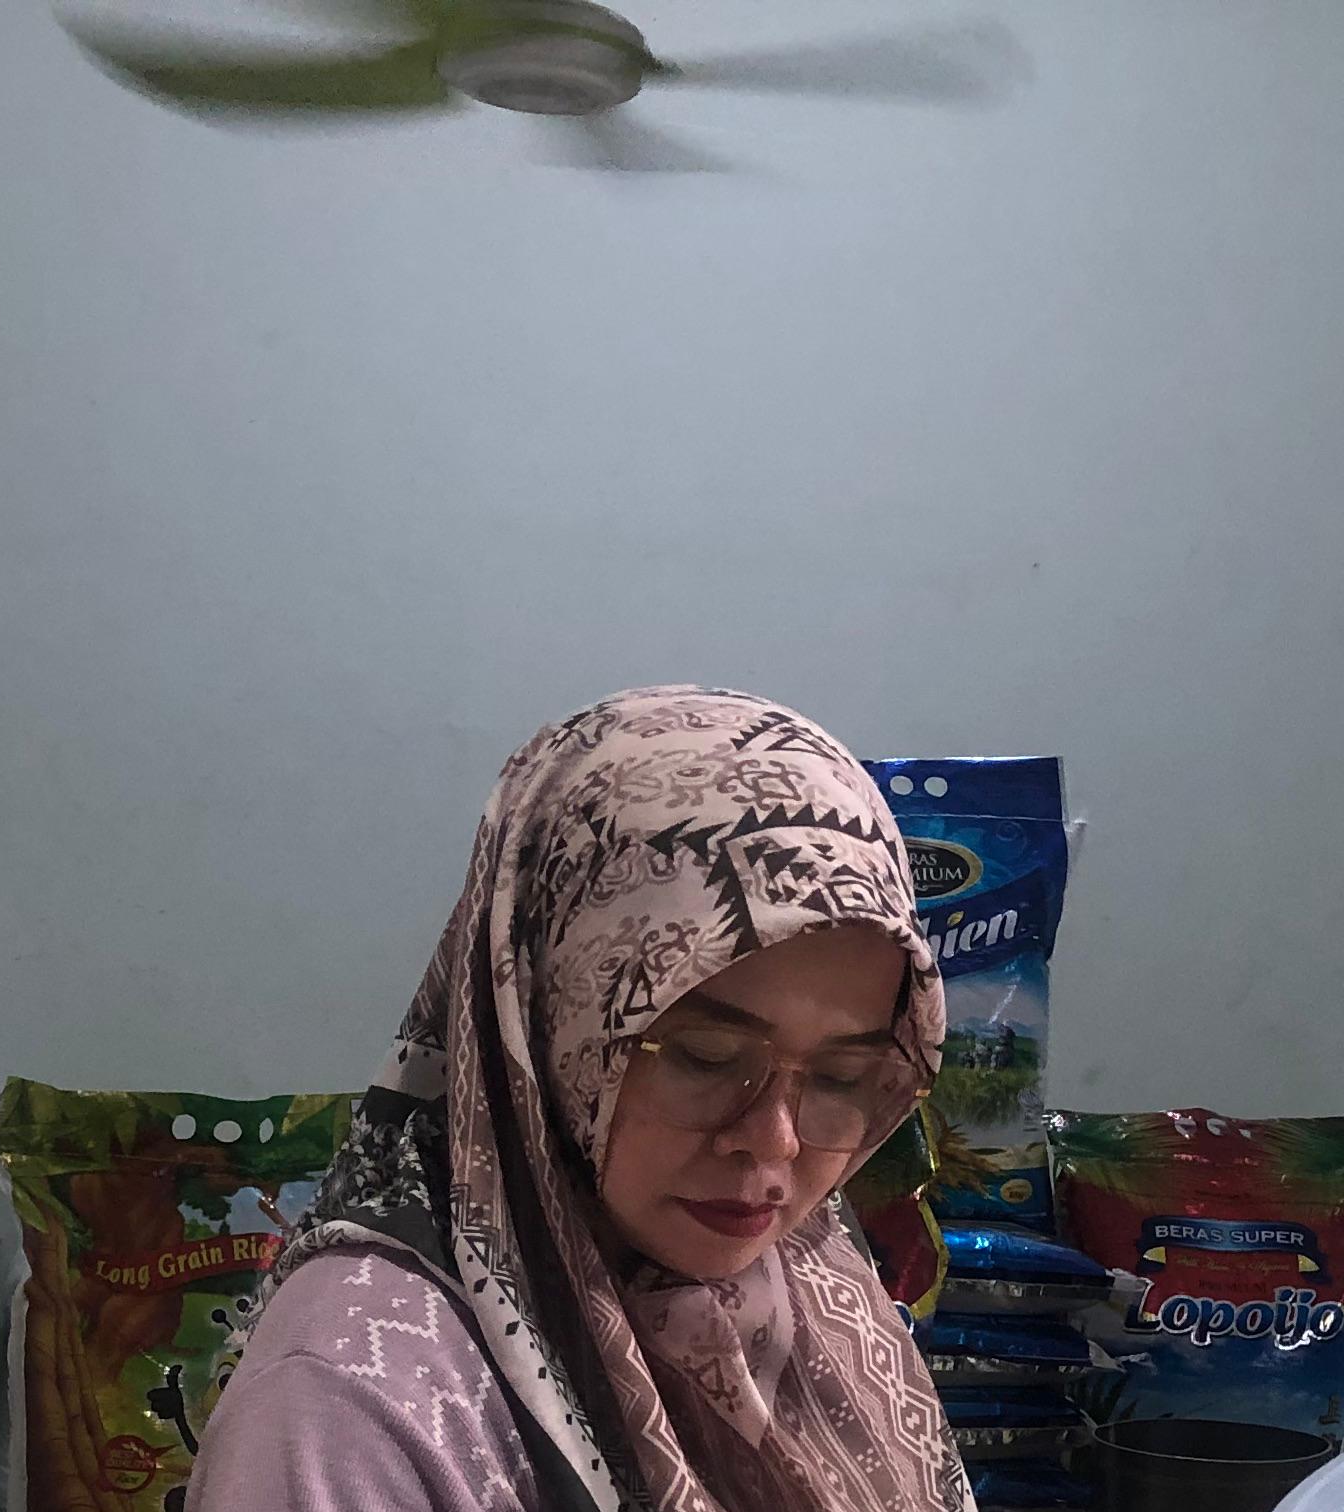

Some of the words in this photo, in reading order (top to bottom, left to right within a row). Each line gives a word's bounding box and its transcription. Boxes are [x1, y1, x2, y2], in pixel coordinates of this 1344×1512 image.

[909, 852, 938, 866] RAS
[1155, 1225, 1223, 1241] BERAS
[1230, 1229, 1305, 1246] SUPER
[96, 1260, 150, 1290] Long
[158, 1243, 225, 1279] Grain
